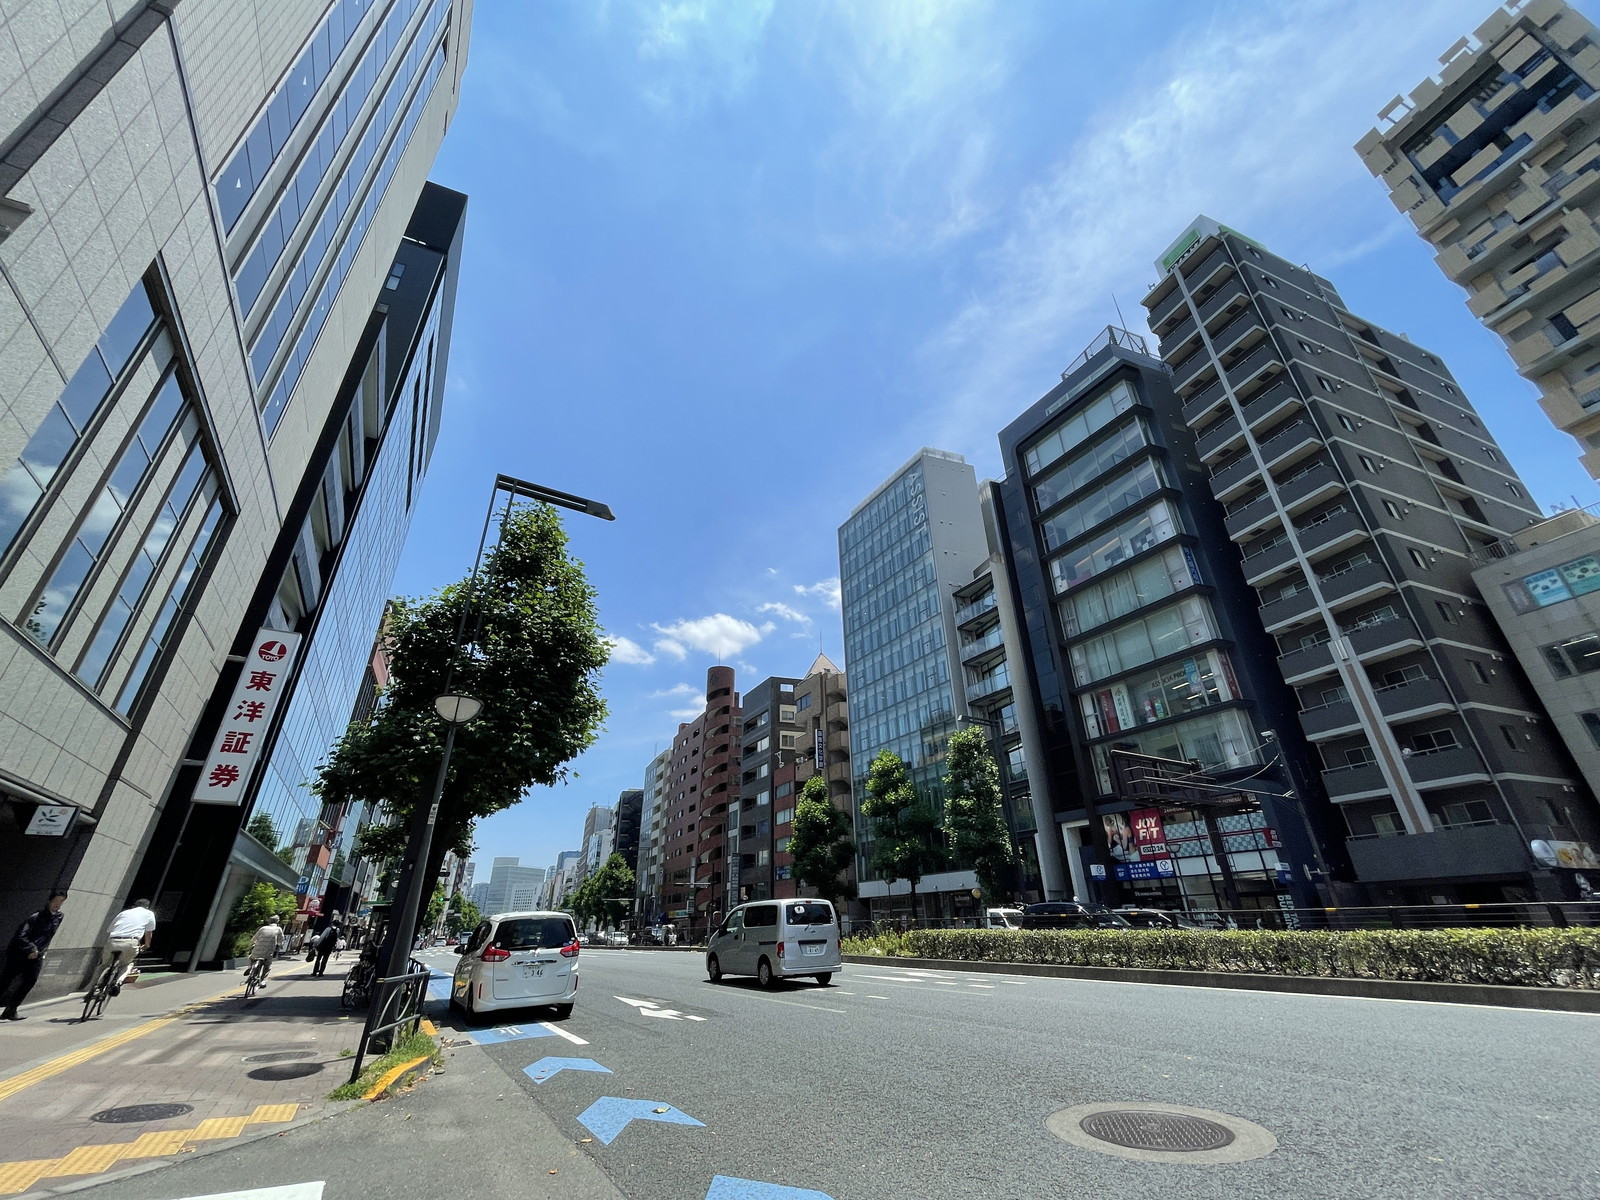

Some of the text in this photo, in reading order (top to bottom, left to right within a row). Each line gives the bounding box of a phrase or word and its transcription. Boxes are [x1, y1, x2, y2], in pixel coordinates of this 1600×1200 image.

[908, 472, 927, 534] ASSIST
[208, 670, 277, 788] 東洋証券
[1135, 816, 1157, 830] JOY
[1139, 827, 1160, 841] FIT
